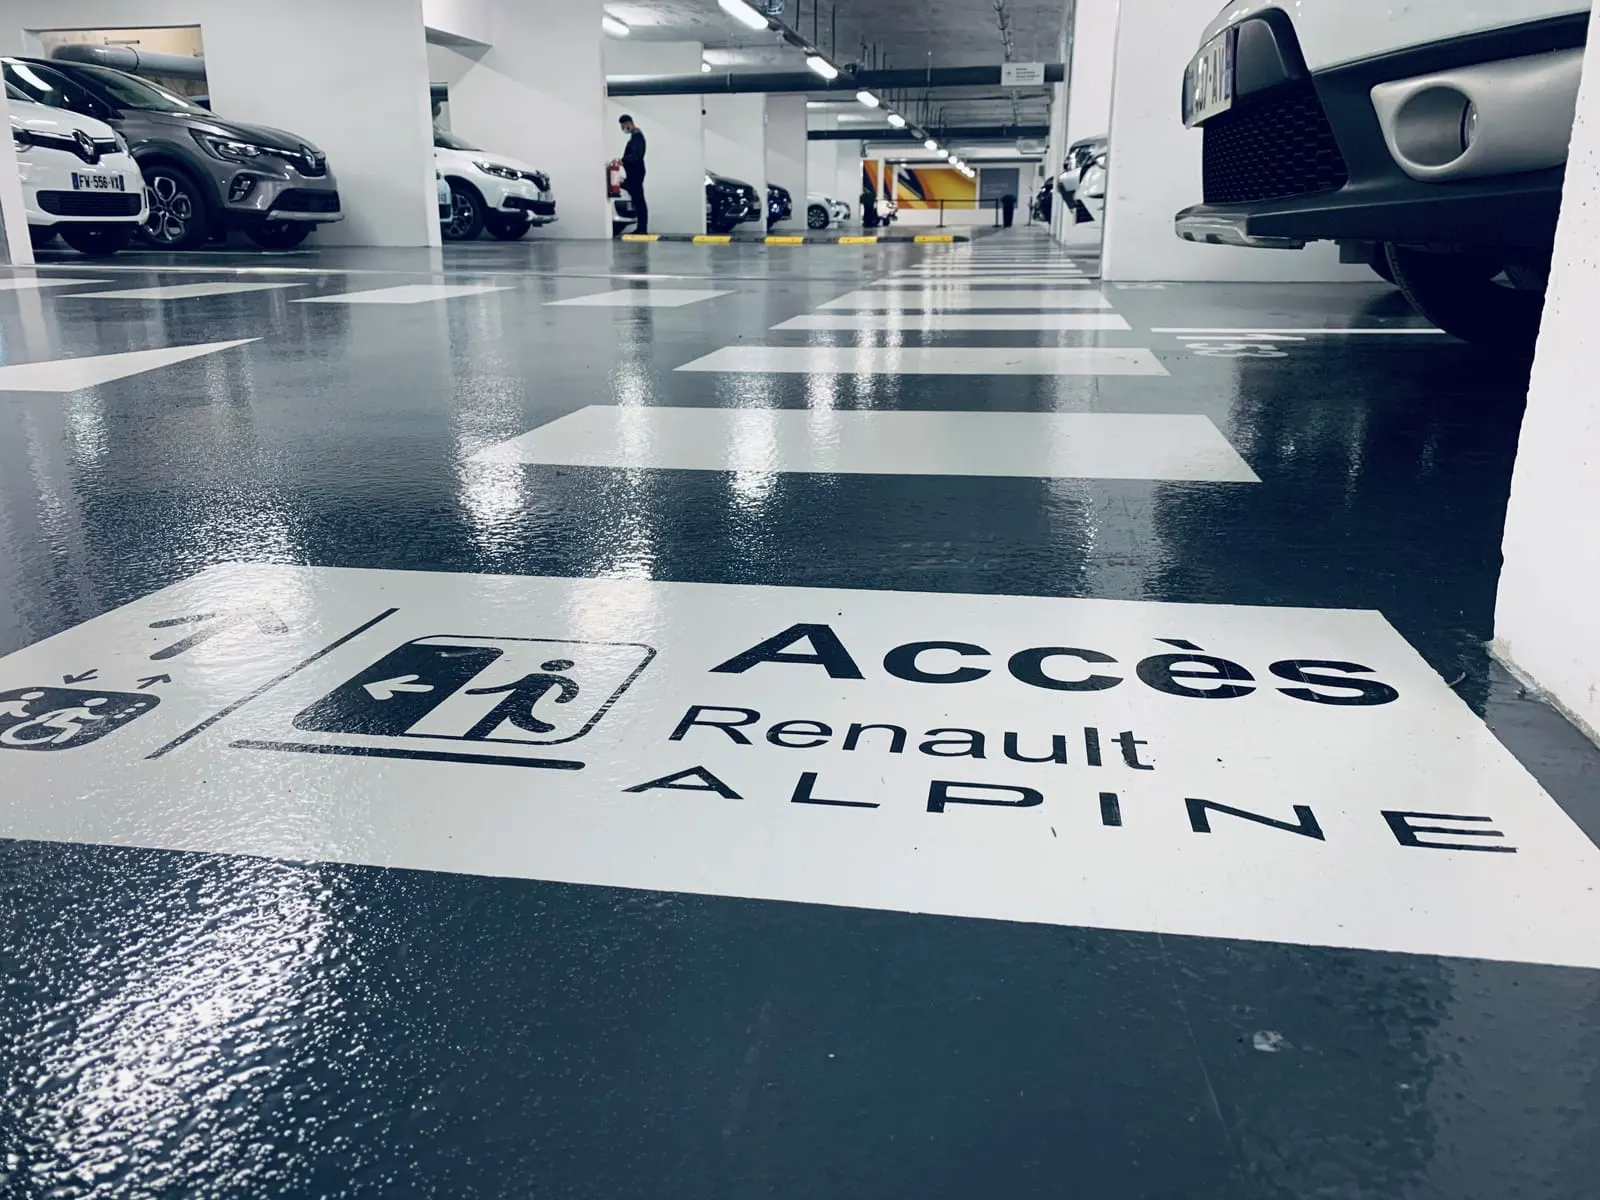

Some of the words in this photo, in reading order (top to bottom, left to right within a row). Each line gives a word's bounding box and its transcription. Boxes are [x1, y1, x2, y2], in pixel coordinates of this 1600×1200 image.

[707, 622, 1400, 706] Accès
[668, 704, 1155, 771] Renault
[621, 765, 1517, 854] ALPINE
